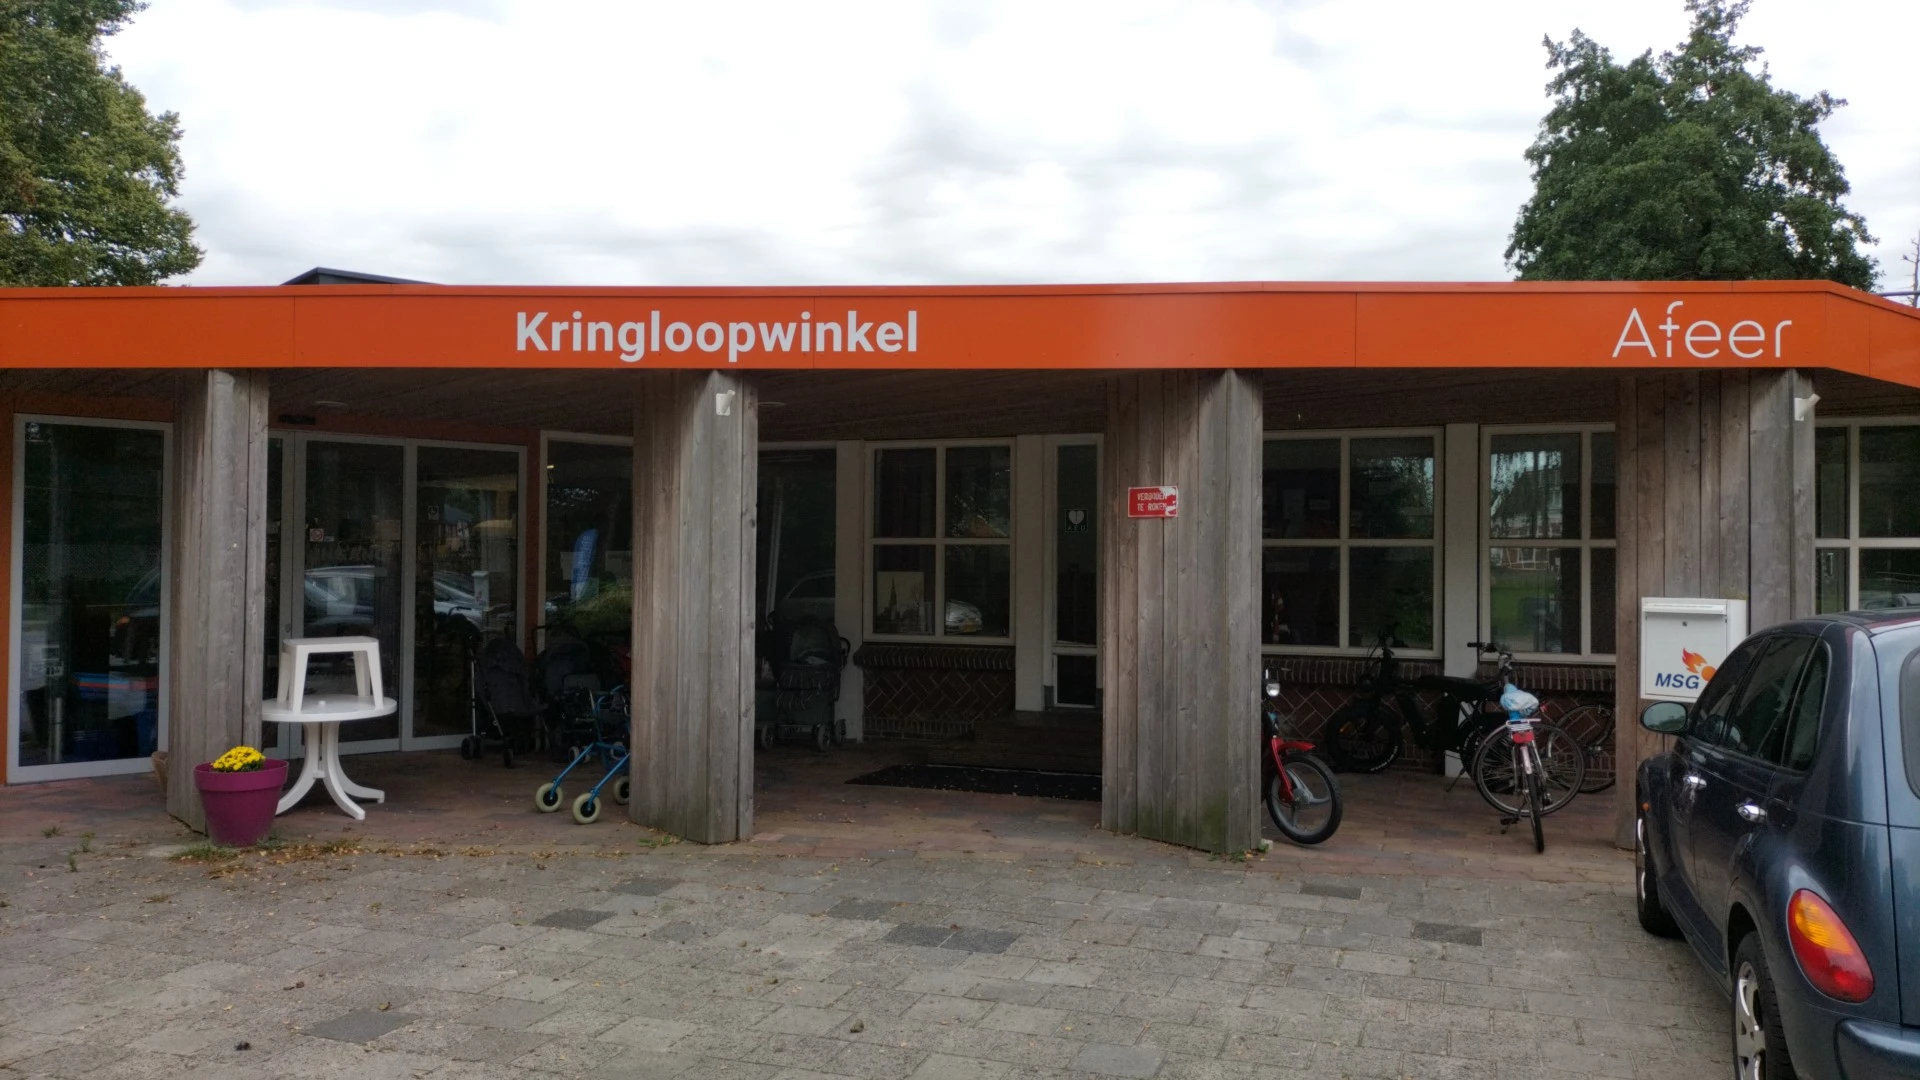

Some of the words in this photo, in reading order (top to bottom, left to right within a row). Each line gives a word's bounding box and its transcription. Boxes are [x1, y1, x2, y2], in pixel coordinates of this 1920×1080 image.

[516, 310, 918, 363] Kringloopwinkel
[1611, 301, 1793, 359] Afeer
[1137, 503, 1144, 511] TE
[1655, 672, 1700, 690] MSG
